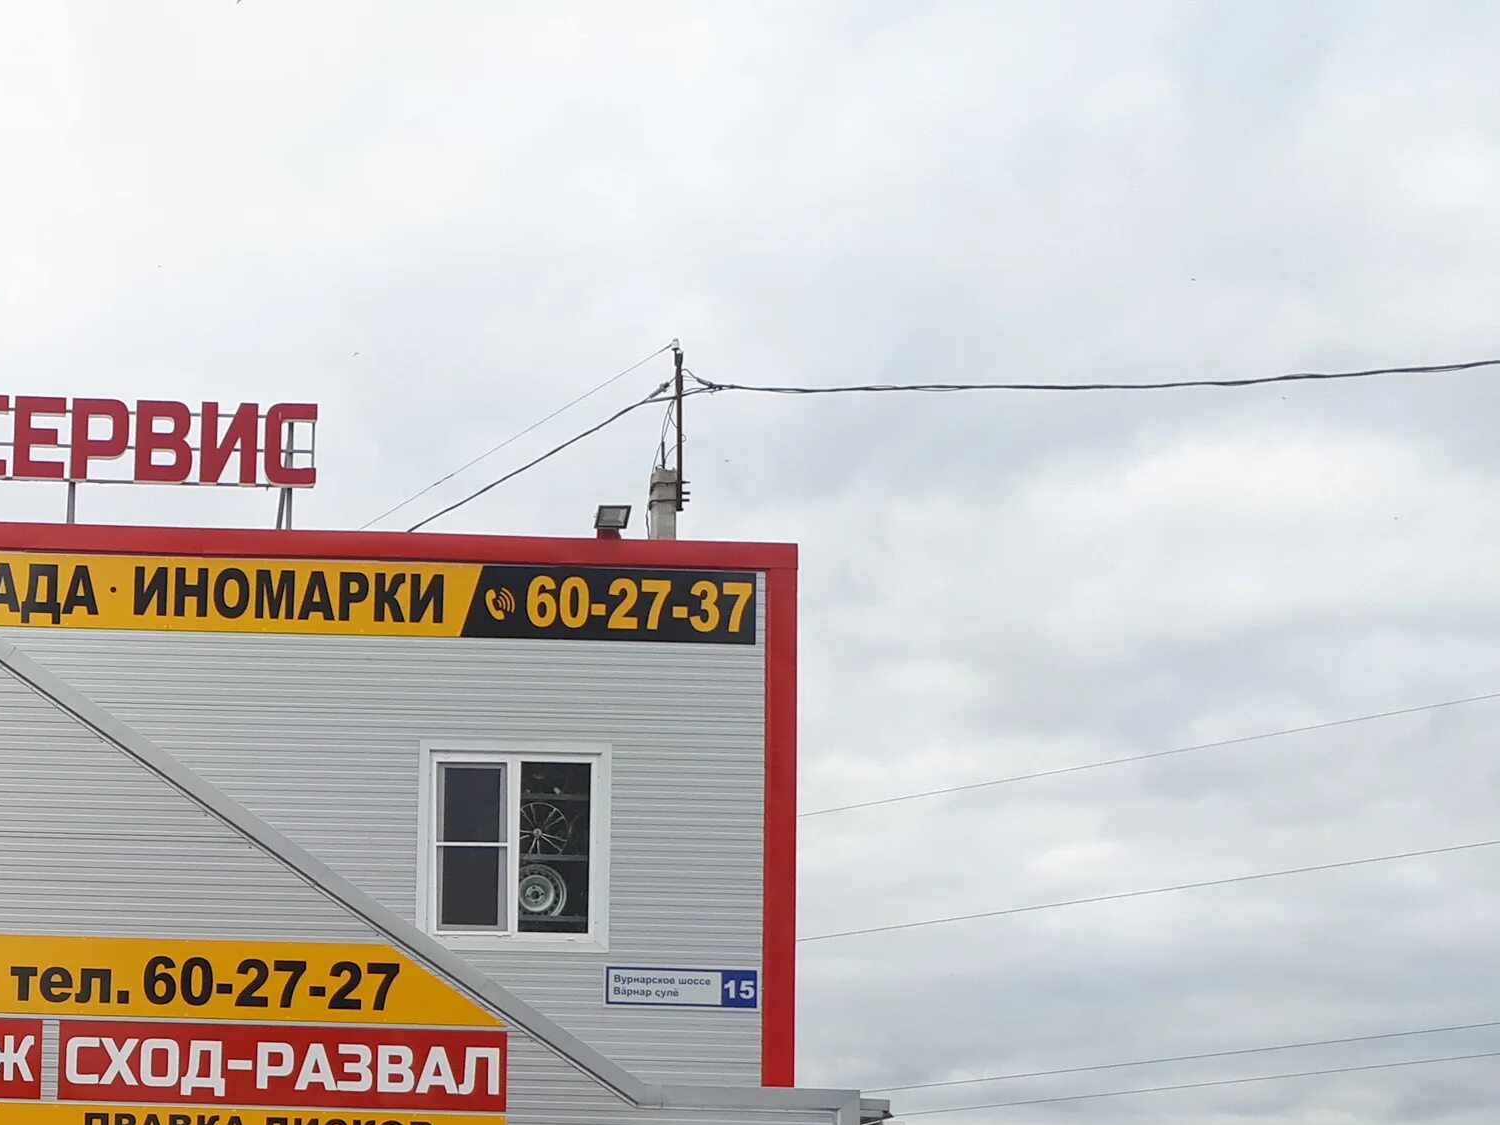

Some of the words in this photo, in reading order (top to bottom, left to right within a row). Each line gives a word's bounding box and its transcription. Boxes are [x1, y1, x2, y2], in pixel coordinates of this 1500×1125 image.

[133, 565, 446, 624] ИНОМАРКИ
[526, 575, 753, 633] 60-27-37
[11, 965, 129, 1005] тел.
[143, 956, 402, 1012] 60-27-27
[613, 974, 675, 987] Вурнарское
[678, 978, 711, 986] шоссе
[723, 979, 755, 1000] 15
[65, 1036, 501, 1096] СХОД-РАЗВАЛ
